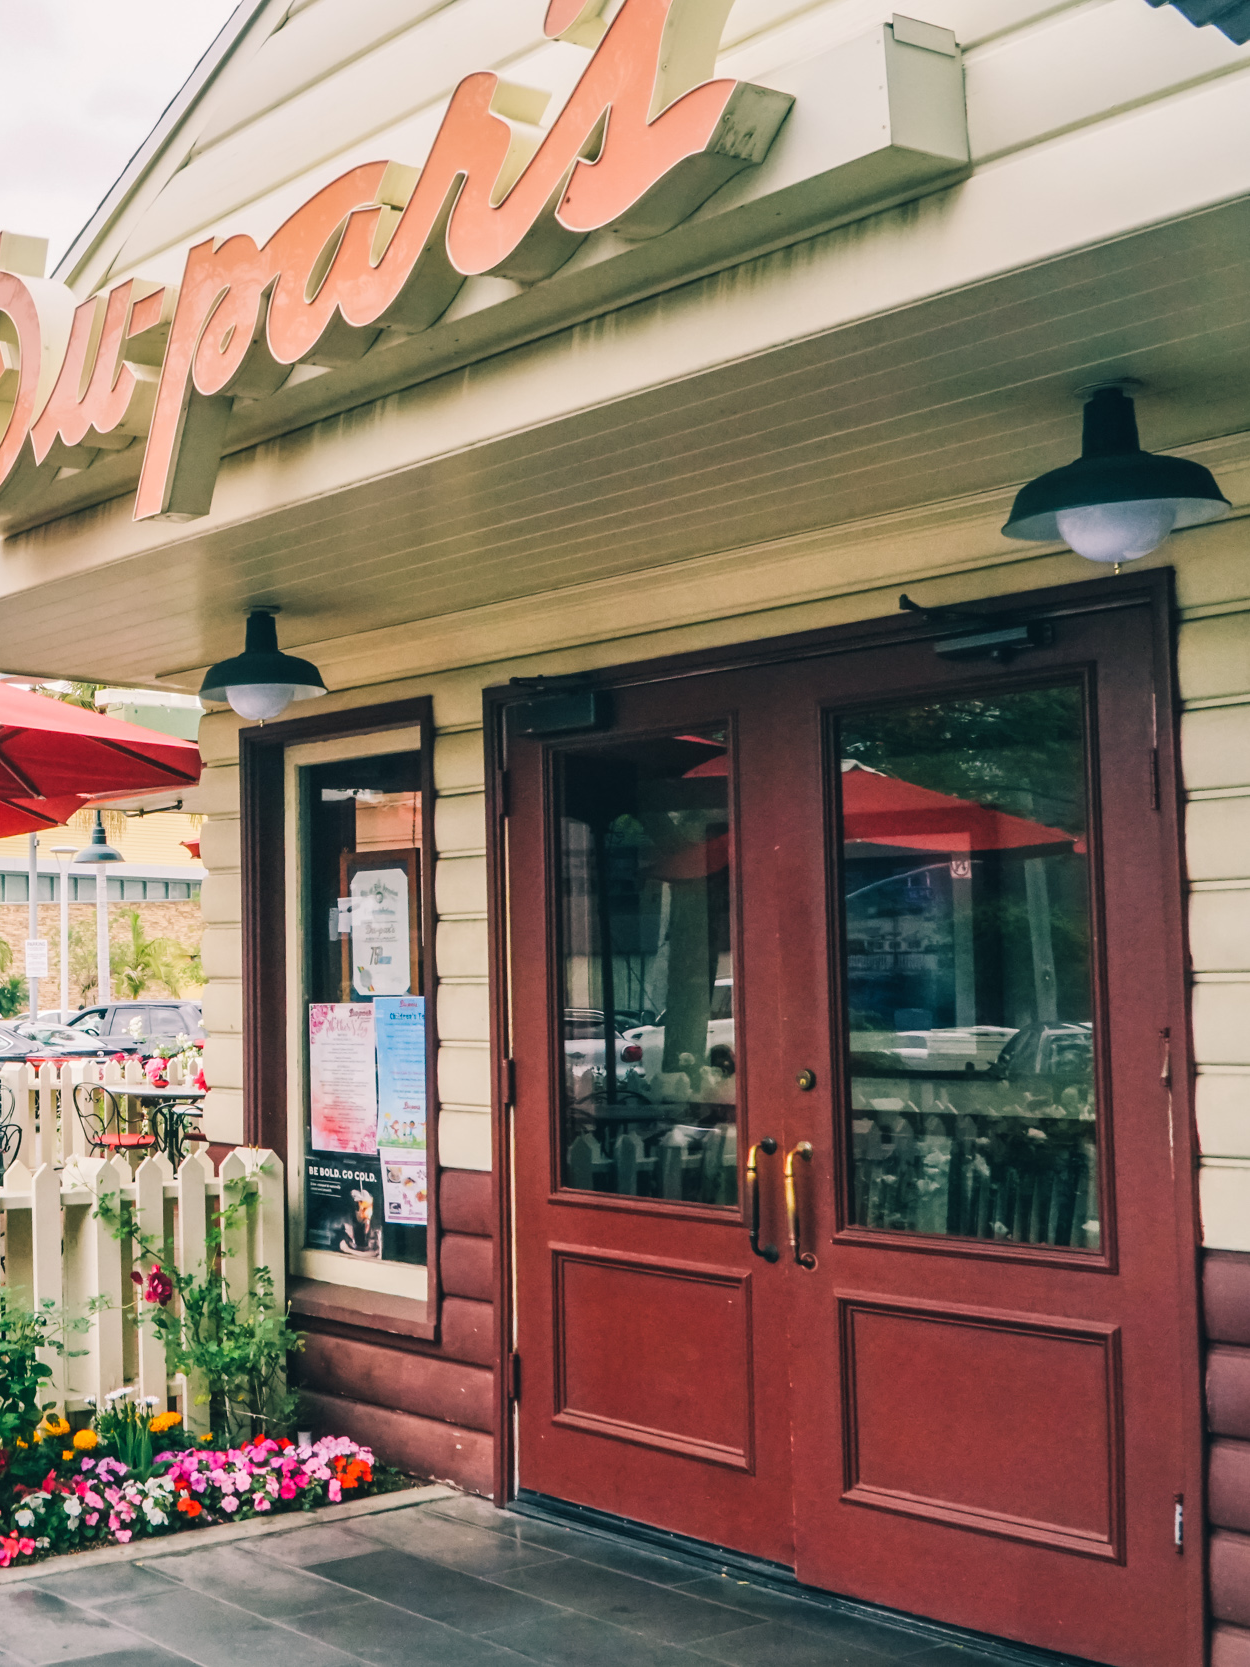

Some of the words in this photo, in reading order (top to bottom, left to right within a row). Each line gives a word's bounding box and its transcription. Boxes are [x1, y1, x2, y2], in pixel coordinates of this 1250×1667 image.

[389, 1012, 417, 1020] Children's
[308, 1166, 319, 1176] BE
[319, 1167, 342, 1178] BOLD.
[342, 1169, 354, 1180] GO
[354, 1171, 378, 1183] COLD.
